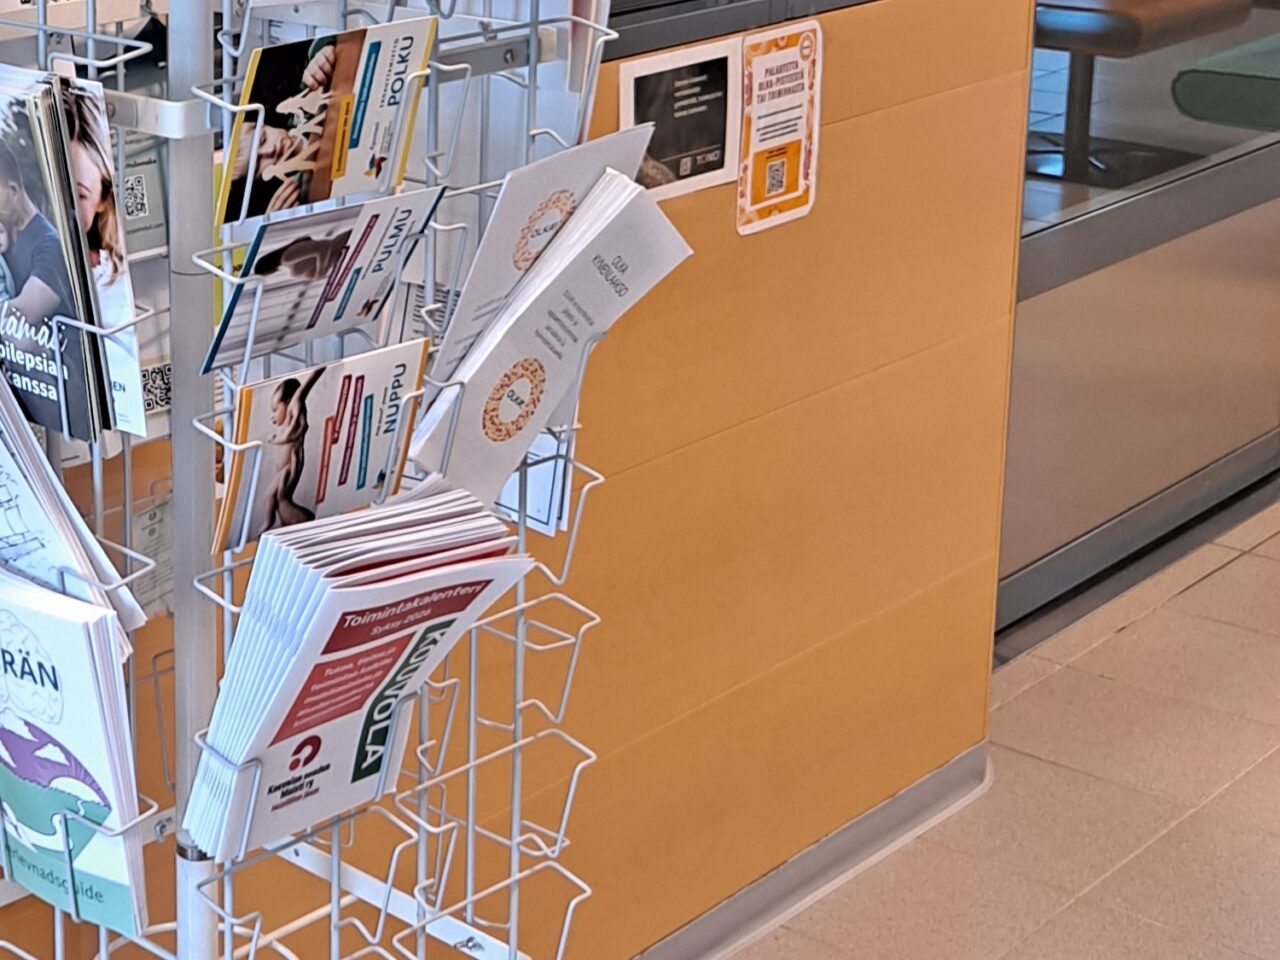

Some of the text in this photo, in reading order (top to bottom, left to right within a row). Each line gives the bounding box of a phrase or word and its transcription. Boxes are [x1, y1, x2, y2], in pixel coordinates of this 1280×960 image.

[387, 36, 414, 107] POLKU
[372, 208, 412, 274] PULMU
[383, 362, 407, 434] NUPPU
[343, 582, 485, 628] Toimintakalenteri
[361, 626, 449, 770] KOUVOLA
